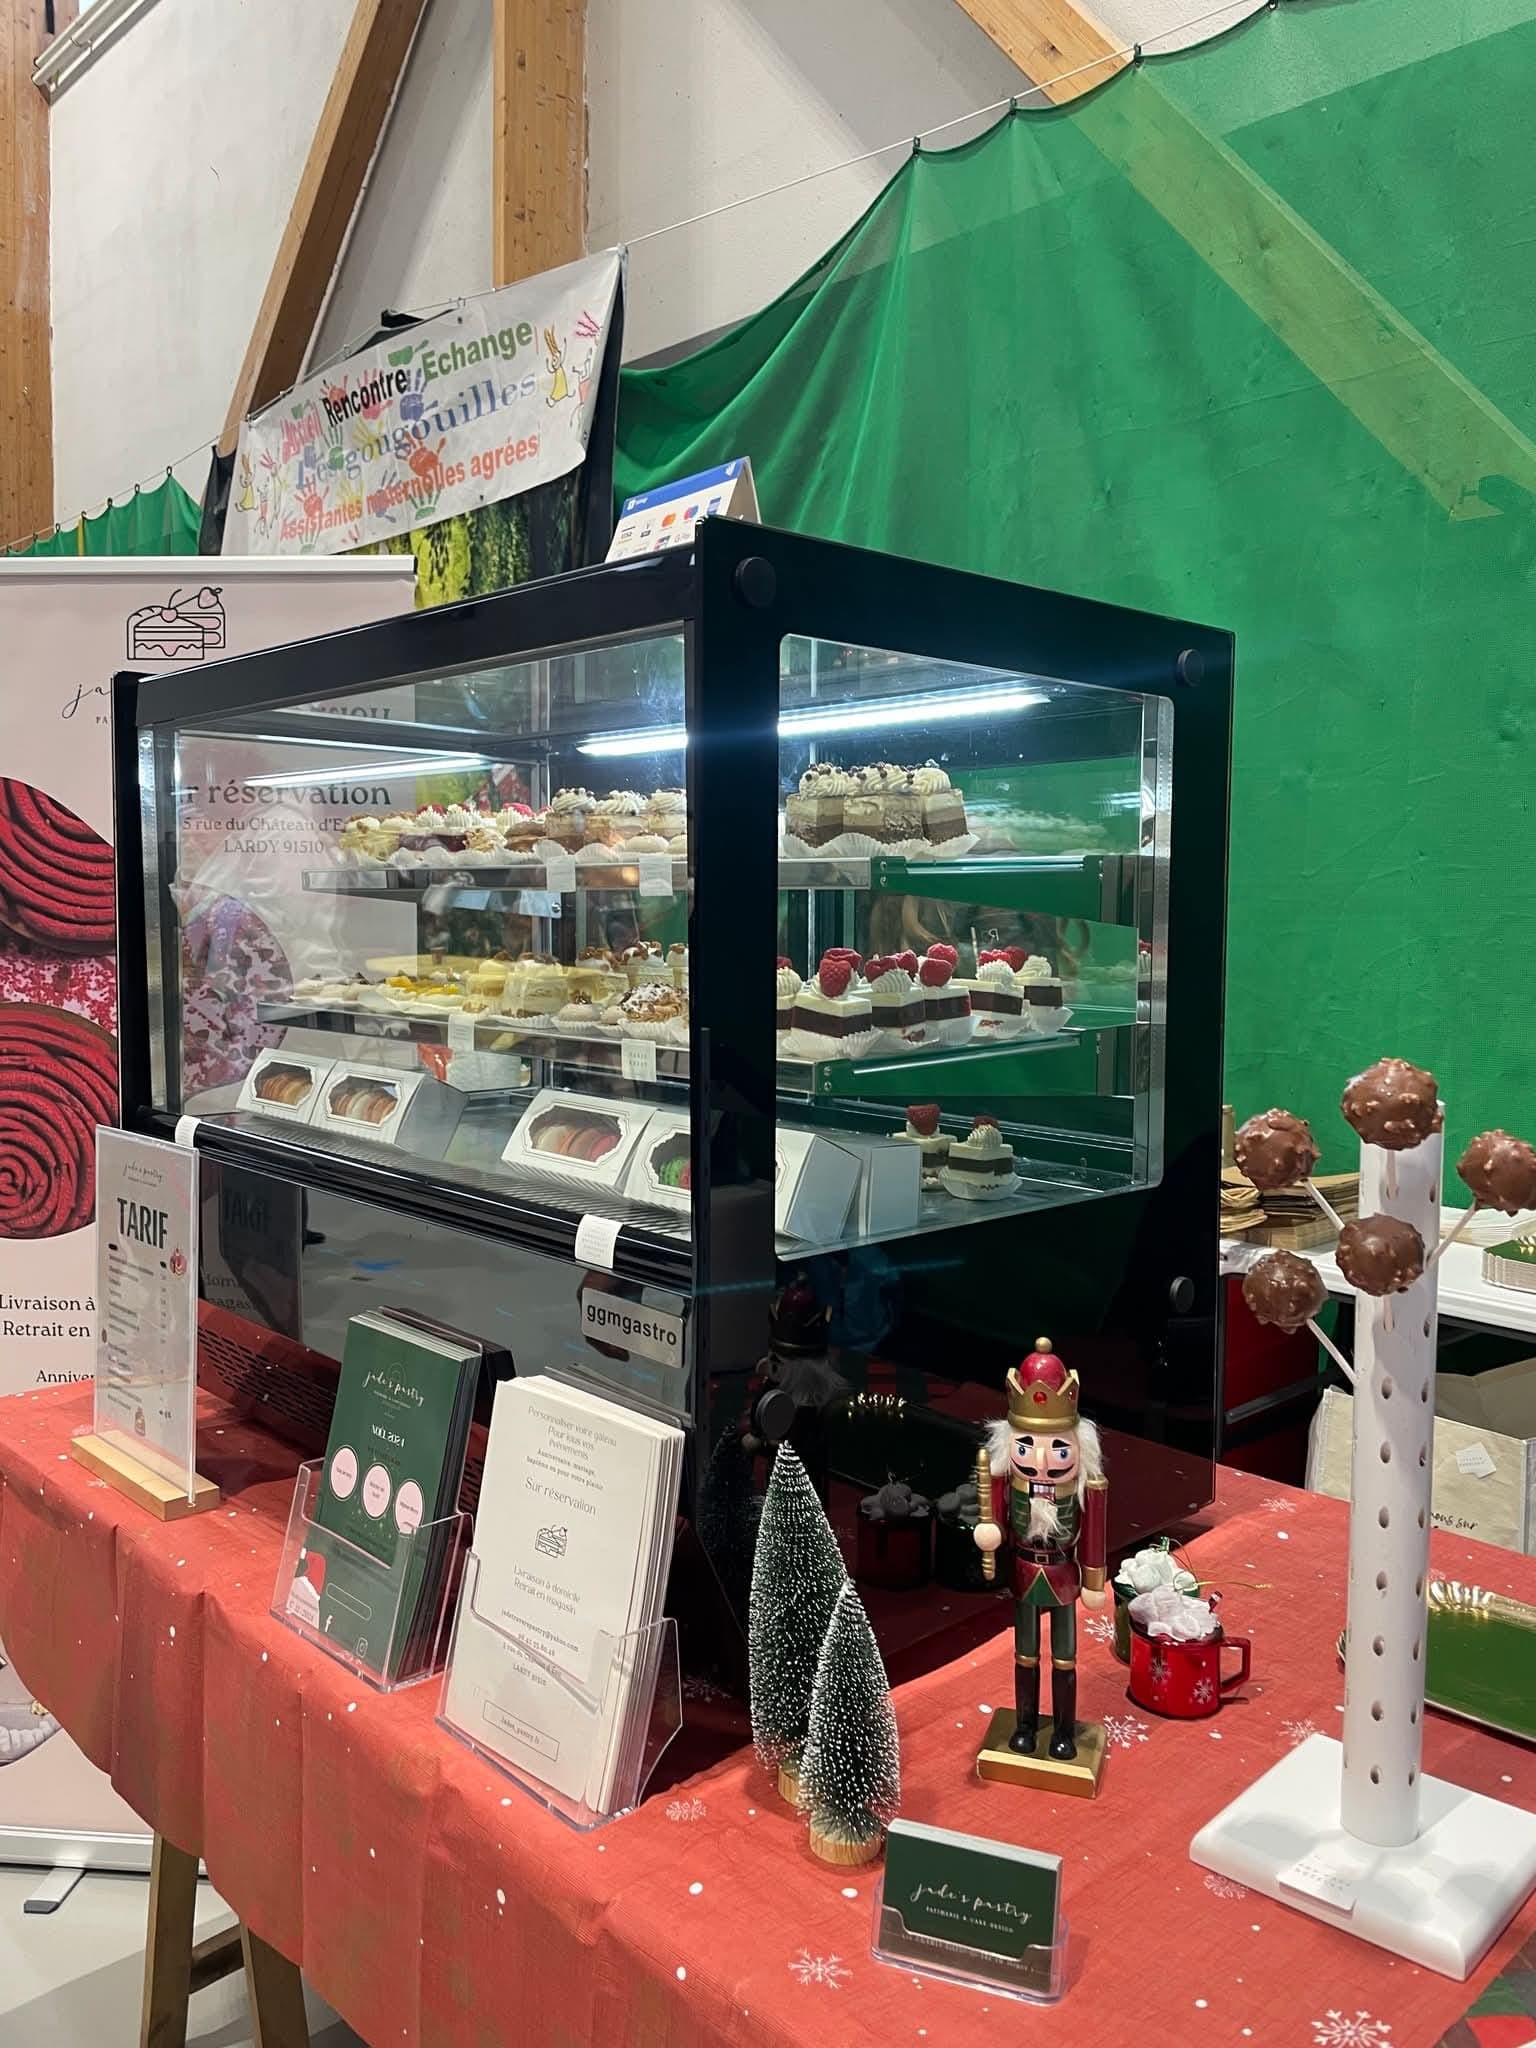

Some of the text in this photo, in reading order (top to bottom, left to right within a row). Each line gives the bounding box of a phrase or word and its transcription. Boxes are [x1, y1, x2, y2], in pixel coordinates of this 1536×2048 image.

[321, 368, 408, 428] Rencontre
[345, 373, 536, 480] gougouilles
[280, 434, 538, 542] Assistantes maternelles agrées
[208, 779, 391, 805] réservation
[196, 820, 222, 832] rue
[226, 817, 246, 832] du
[250, 817, 315, 832] Château
[224, 839, 324, 854] LARDY 91510
[117, 1197, 169, 1249] TARIF
[0, 1294, 96, 1311] Livraison à
[3, 1320, 91, 1337] Retrait en
[586, 1304, 677, 1346] ggmgastro
[525, 1475, 597, 1515] Sur réservation
[910, 1882, 1033, 1925] jade's pastry
